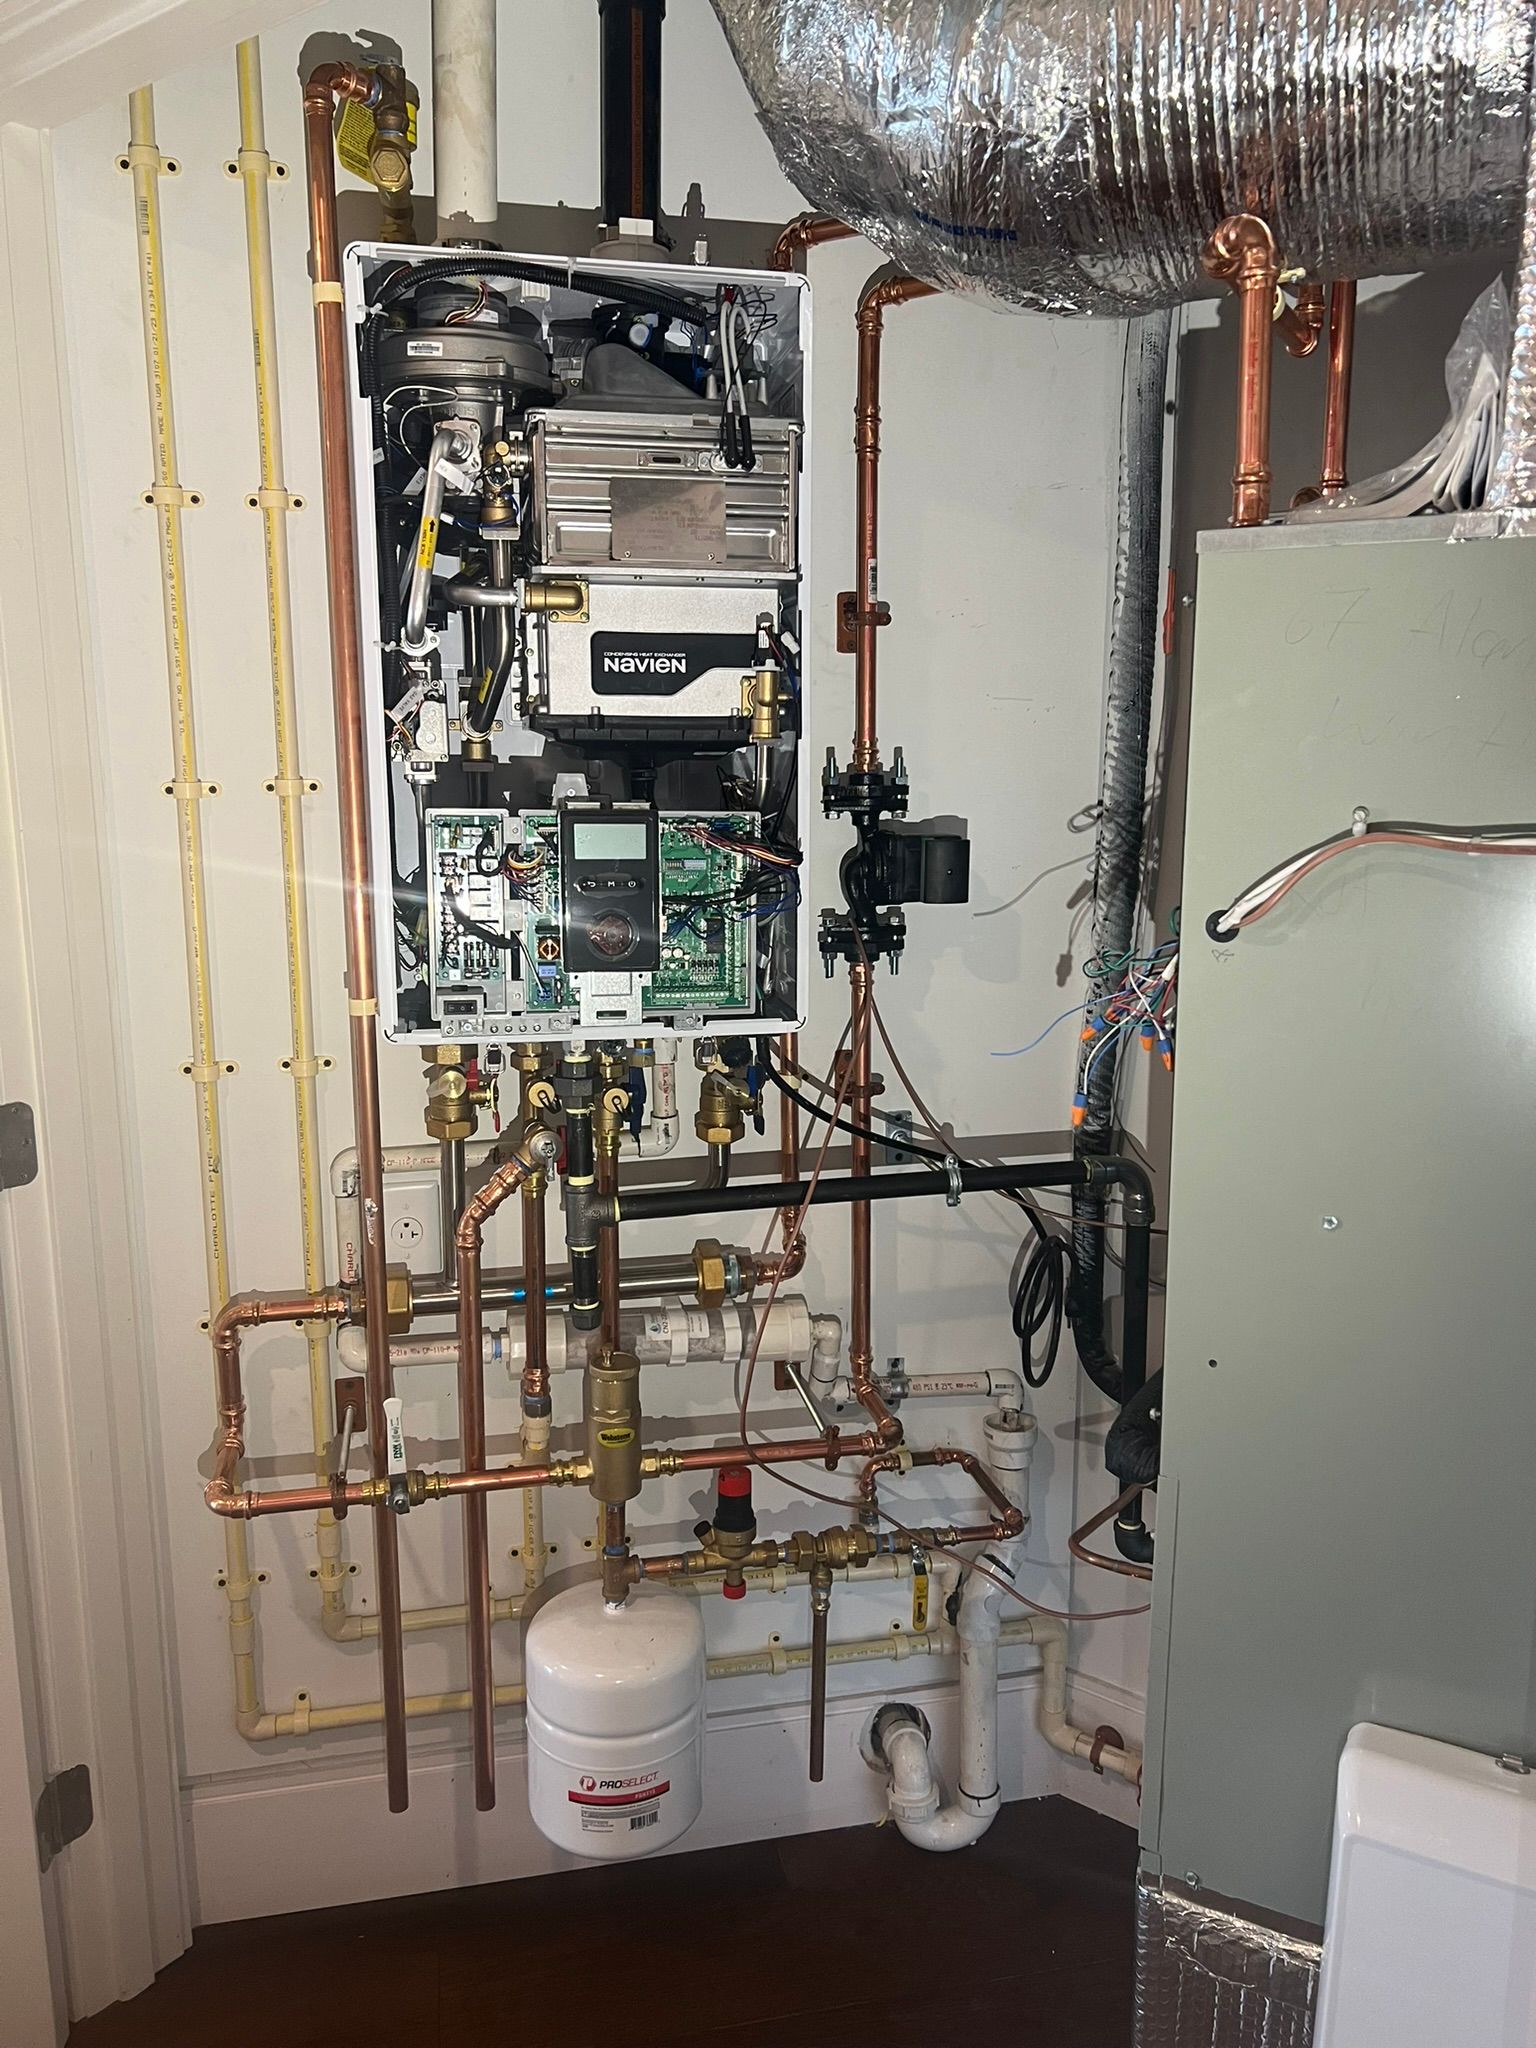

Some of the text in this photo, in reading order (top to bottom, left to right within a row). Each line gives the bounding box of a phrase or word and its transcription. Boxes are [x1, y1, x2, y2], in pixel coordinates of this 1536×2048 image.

[157, 402, 162, 410] IN
[209, 1190, 220, 1259] CHARLOTTE
[599, 1771, 658, 1789] PROSELECT
